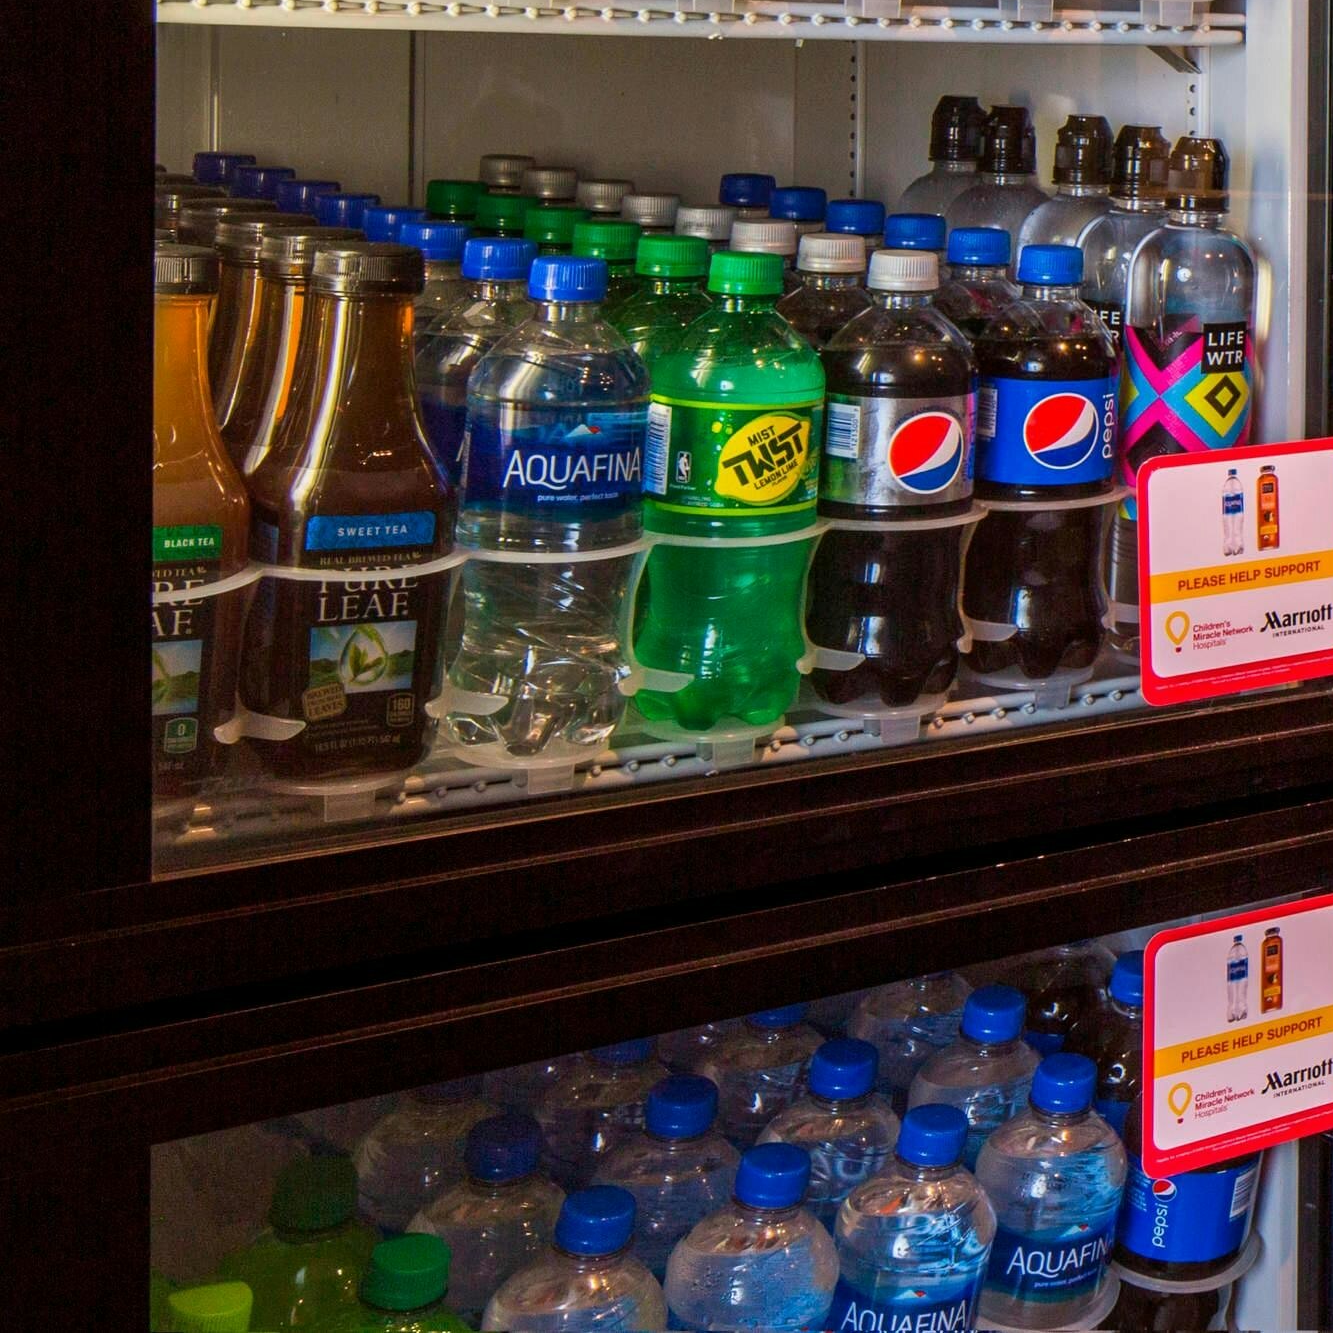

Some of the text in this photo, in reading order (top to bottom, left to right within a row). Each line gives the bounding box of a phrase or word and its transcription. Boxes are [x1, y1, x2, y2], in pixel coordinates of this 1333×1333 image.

[1208, 330, 1244, 347] LIFE
[1206, 350, 1244, 366] WTR
[748, 425, 776, 447] MIST
[1102, 392, 1114, 460] pepsi
[503, 446, 641, 491] AQUAFINA
[754, 459, 799, 490] LEMON LIME
[537, 492, 555, 502] pure
[337, 525, 408, 537] SWEET TEA
[164, 537, 215, 549] BLACK TEA
[1178, 560, 1321, 592] PLEASE HELP SUPPORT
[1192, 620, 1231, 633] Children's
[1259, 603, 1333, 633] Marriott
[1193, 625, 1254, 641] Miracle Network
[1272, 625, 1325, 638] INTERNATIONAL
[1192, 639, 1226, 651] Hospitals
[1181, 1017, 1323, 1063] PLEASE HELP SUPPORT
[1261, 1057, 1333, 1096] Marriott
[1194, 1085, 1233, 1102] Children's
[1195, 1088, 1256, 1110] Miracle Network
[1273, 1079, 1326, 1099] INTERNATIONAL
[1151, 1202, 1169, 1249] pepsi
[840, 1299, 968, 1333] AQUAFINA
